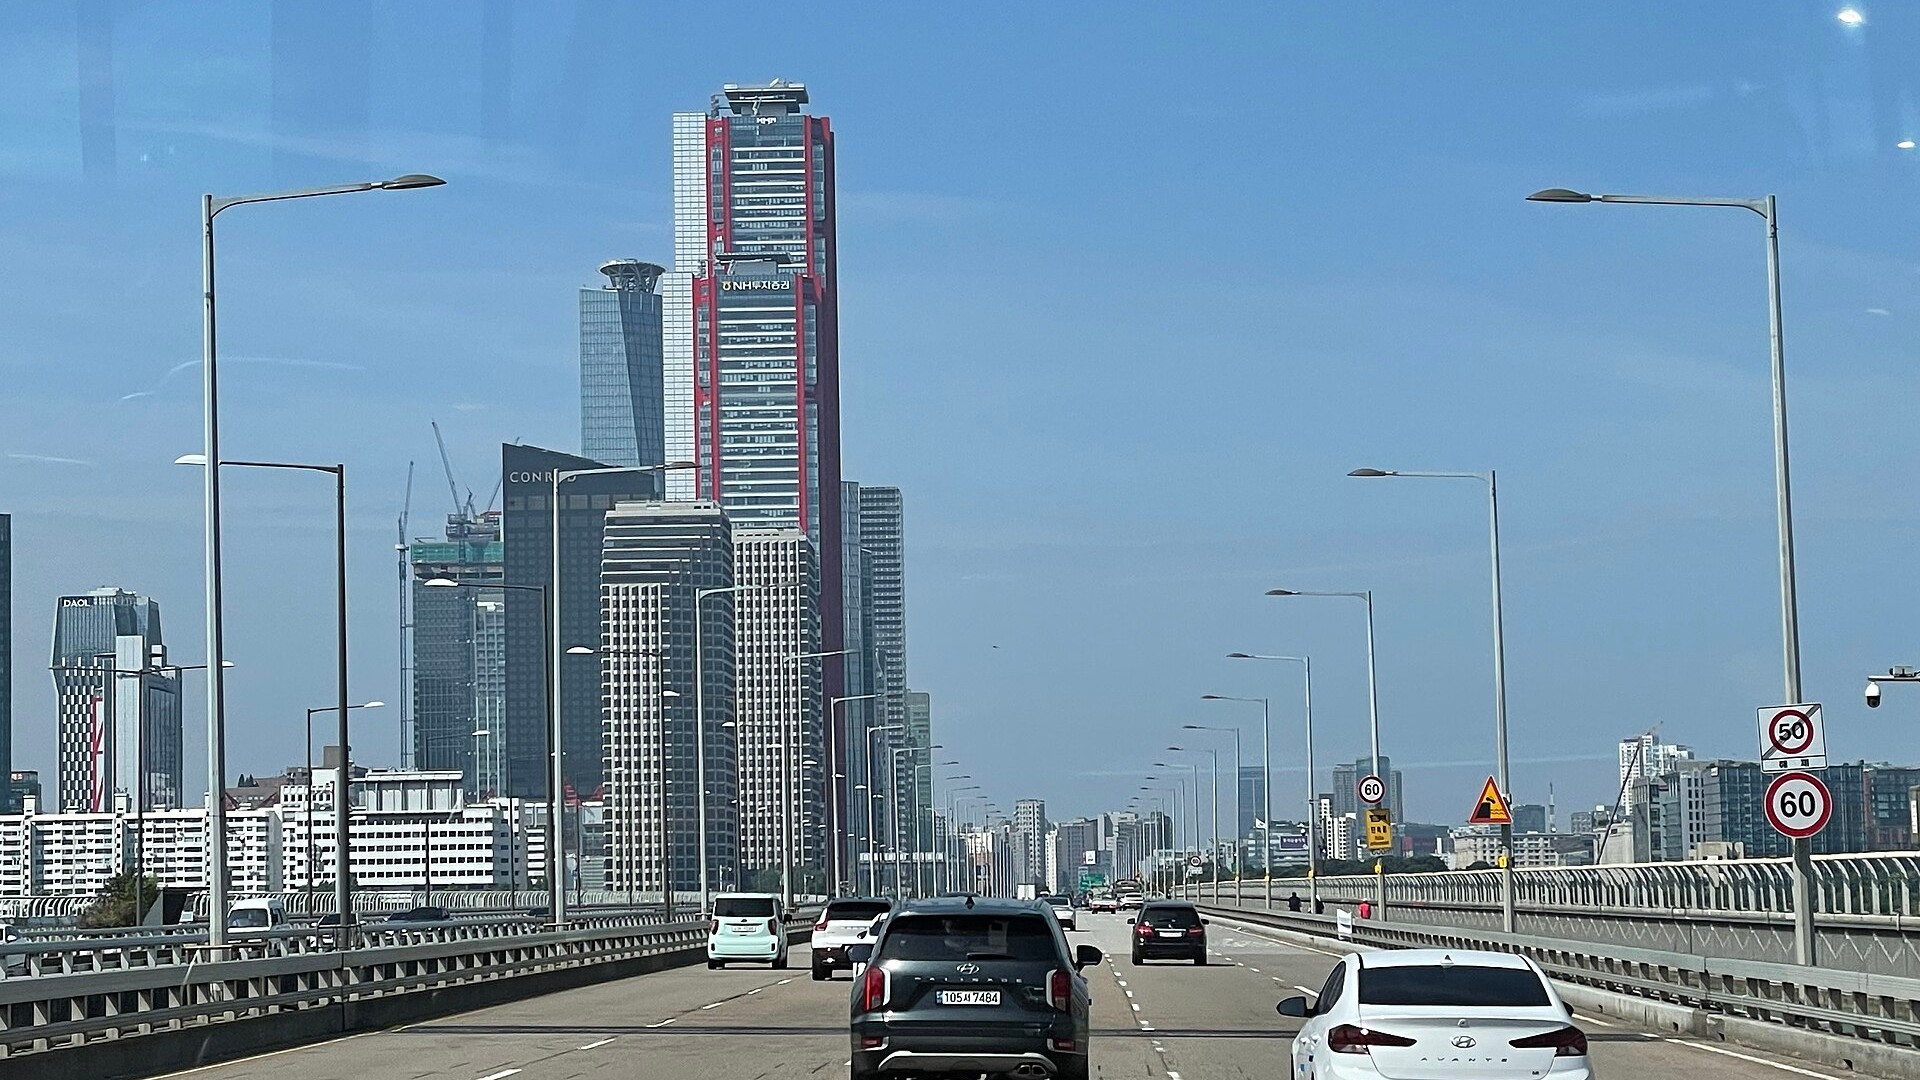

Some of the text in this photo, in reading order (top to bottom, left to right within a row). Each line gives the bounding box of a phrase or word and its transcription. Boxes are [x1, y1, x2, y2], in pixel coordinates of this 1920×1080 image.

[63, 599, 91, 608] DAOL
[1779, 722, 1804, 740] 50
[1364, 783, 1380, 796] 60
[1780, 791, 1816, 818] 60
